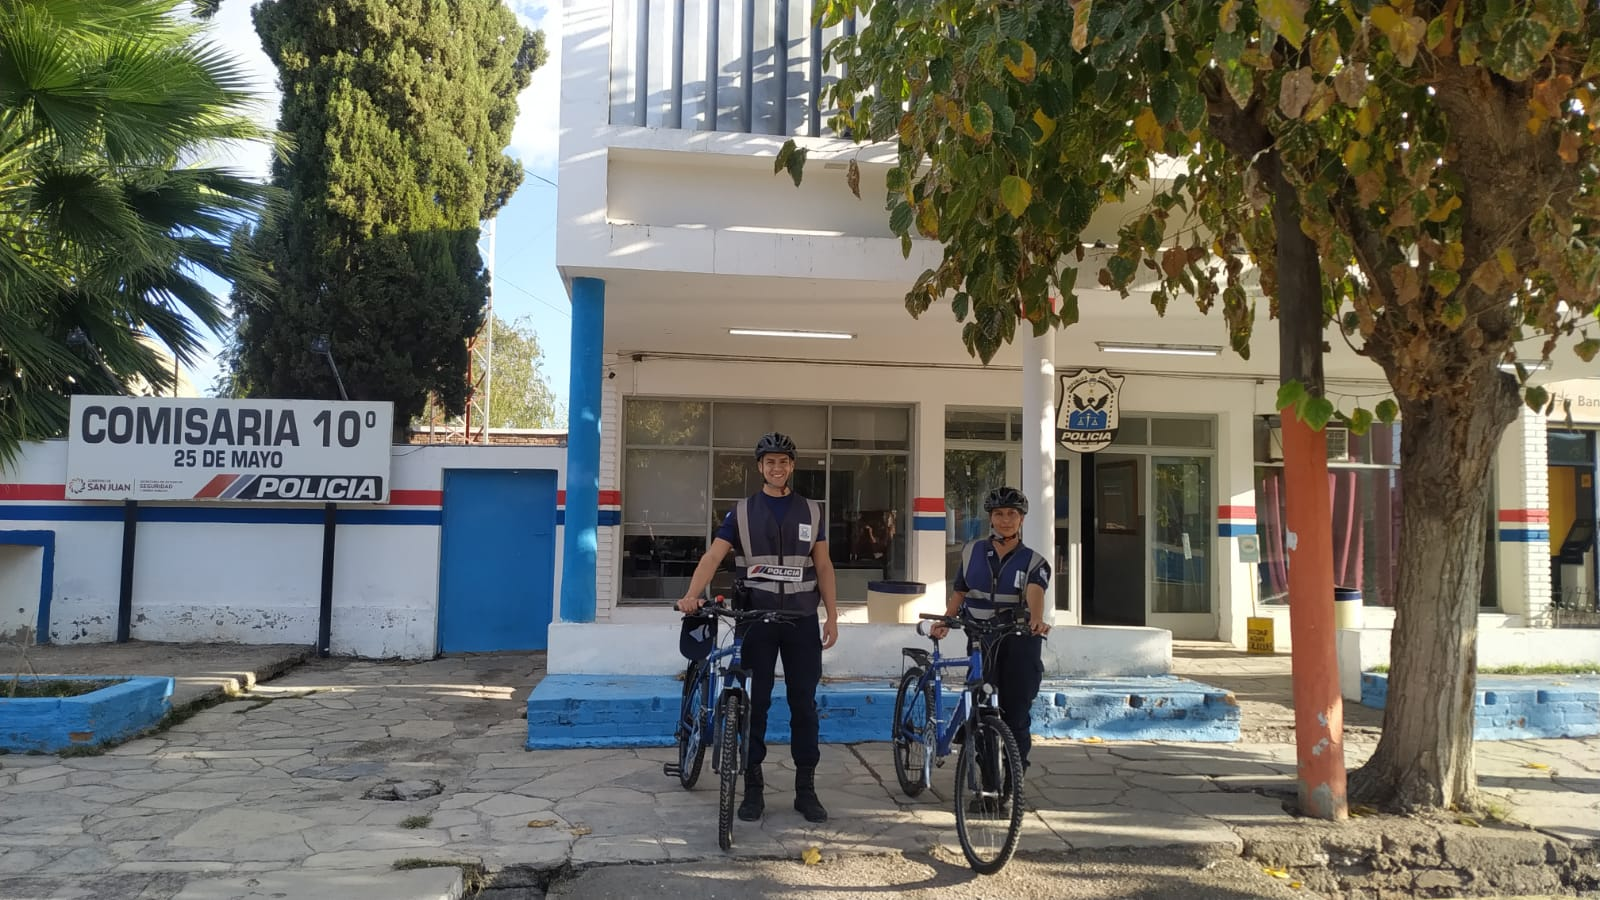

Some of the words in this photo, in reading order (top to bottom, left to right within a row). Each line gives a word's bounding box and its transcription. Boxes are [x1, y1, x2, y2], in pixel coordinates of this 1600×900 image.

[82, 405, 300, 447] COMISARIA
[1061, 431, 1112, 441] POLICIA
[174, 449, 197, 468] 25
[202, 450, 226, 468] DE
[231, 450, 283, 469] MAYO
[88, 483, 106, 491] SAN
[107, 483, 131, 491] JUAN
[256, 477, 377, 499] POLICIA
[767, 567, 800, 577] POLICIA
